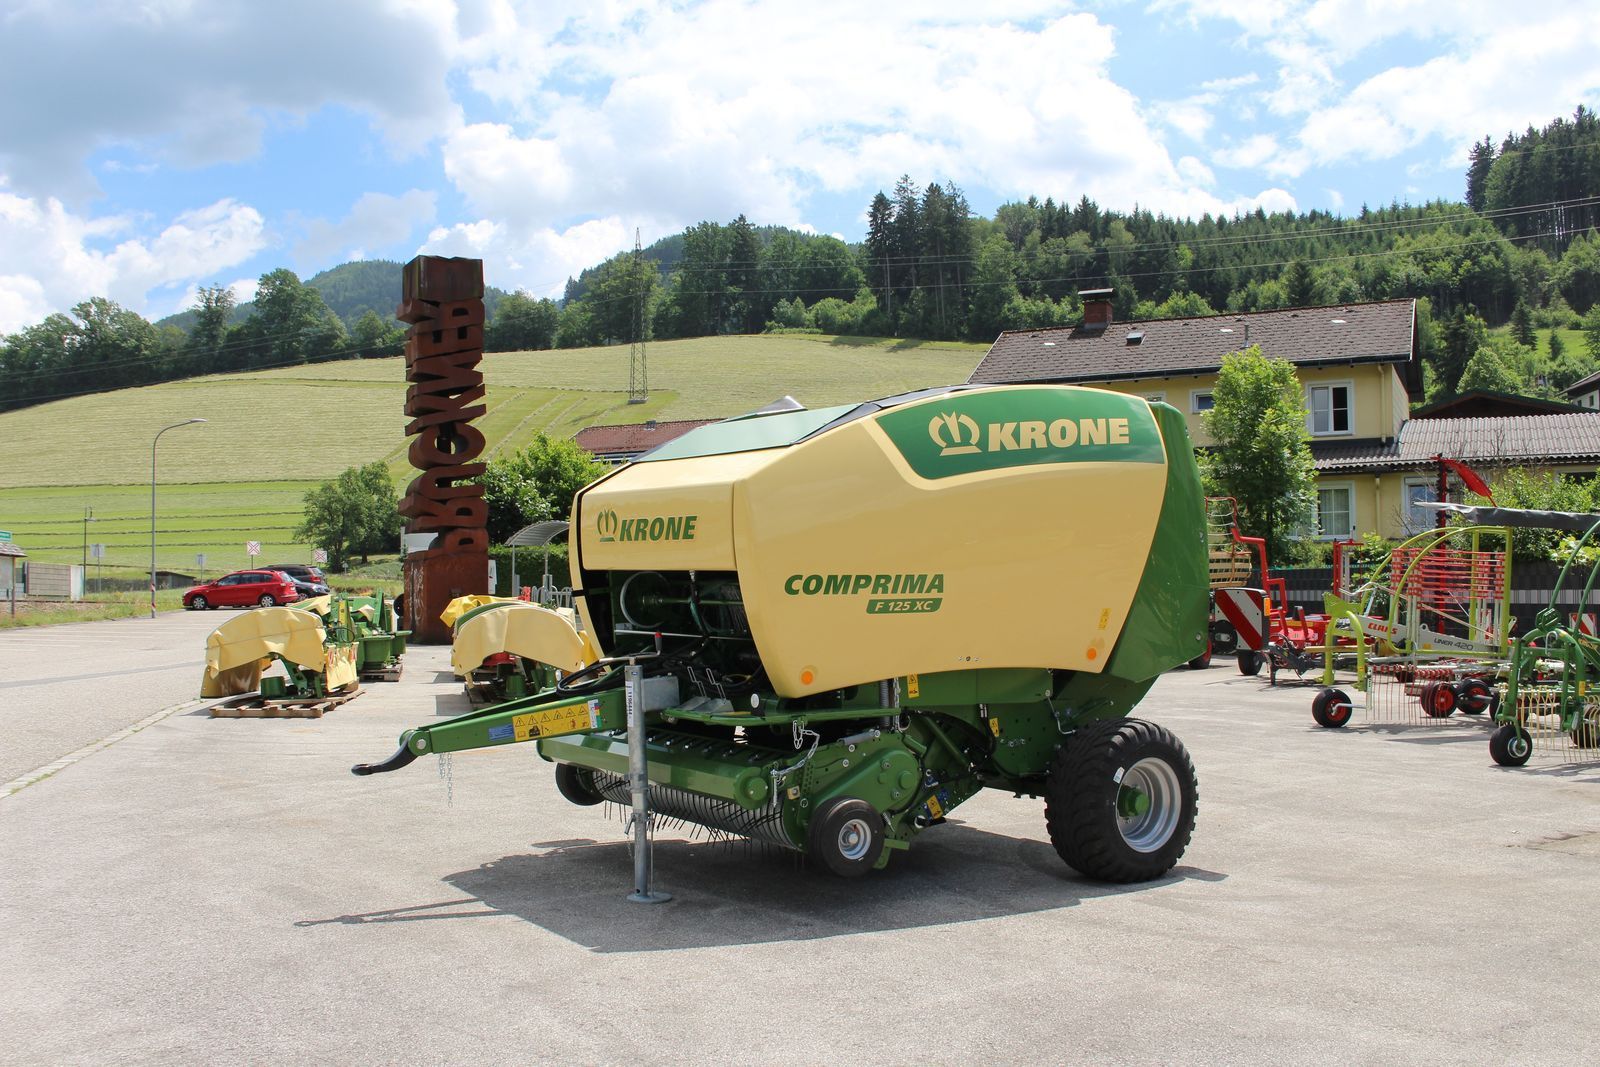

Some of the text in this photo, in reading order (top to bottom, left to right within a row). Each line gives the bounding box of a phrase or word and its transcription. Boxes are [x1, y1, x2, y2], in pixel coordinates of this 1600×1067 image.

[988, 418, 1130, 452] KRONE
[619, 515, 698, 542] KRONE
[784, 573, 944, 596] COMPRIMA
[874, 600, 934, 612] F 125 XC
[1434, 637, 1474, 651] LINER 420
